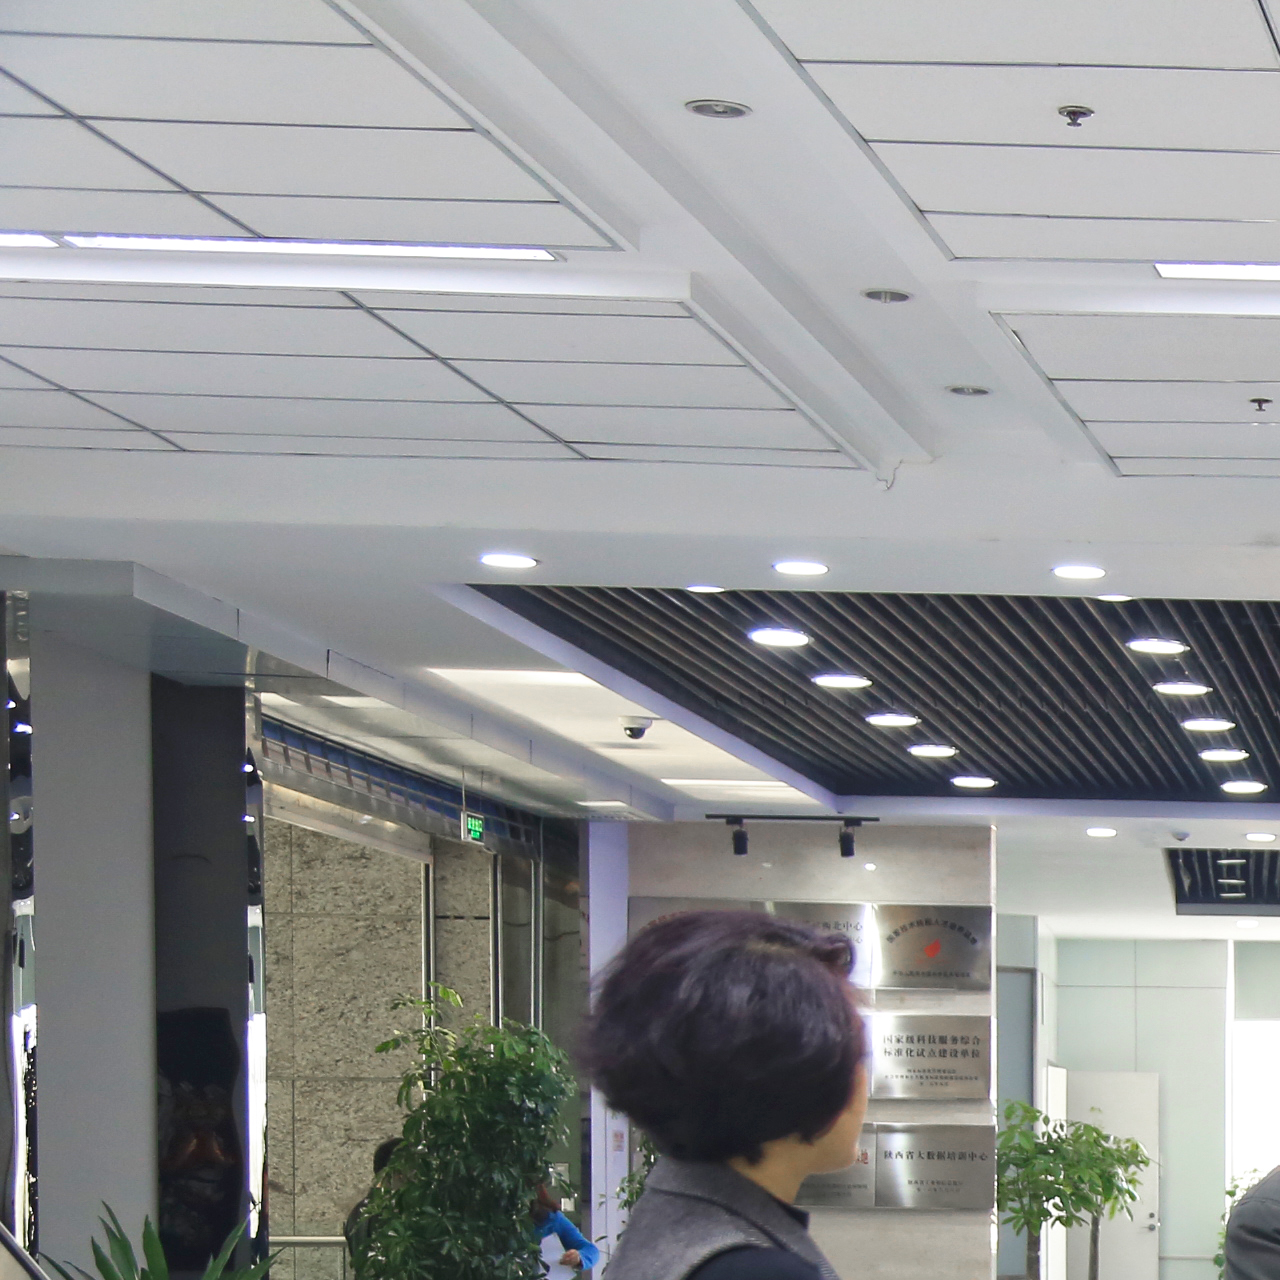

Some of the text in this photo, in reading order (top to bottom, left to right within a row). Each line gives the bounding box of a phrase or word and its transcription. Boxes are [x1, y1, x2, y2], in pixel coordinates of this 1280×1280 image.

[883, 1034, 981, 1046] 国家级科技服务综合
[883, 1047, 981, 1059] 标准化试点建设单位
[884, 1149, 989, 1162] 陕西省大数据培训中心
